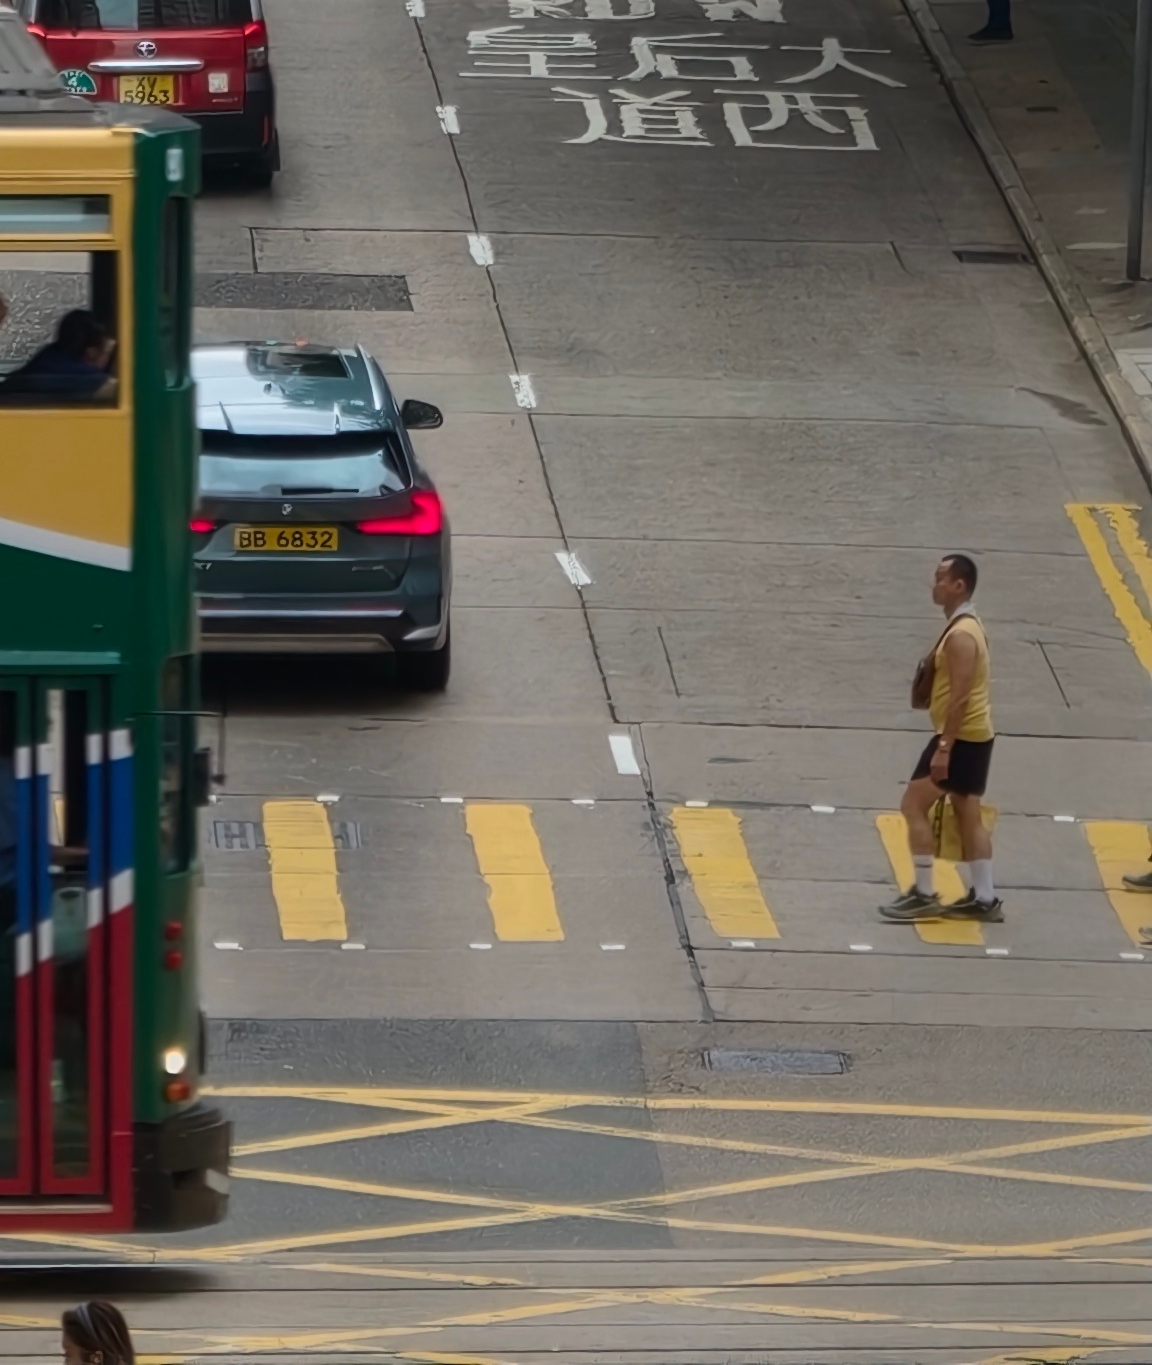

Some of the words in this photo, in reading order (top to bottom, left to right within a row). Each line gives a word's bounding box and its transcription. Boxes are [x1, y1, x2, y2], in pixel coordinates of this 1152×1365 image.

[459, 25, 908, 87] 皇后大
[123, 90, 170, 104] 5963
[551, 87, 882, 151] 道西
[239, 530, 267, 549] BB
[276, 530, 333, 549] 6832
